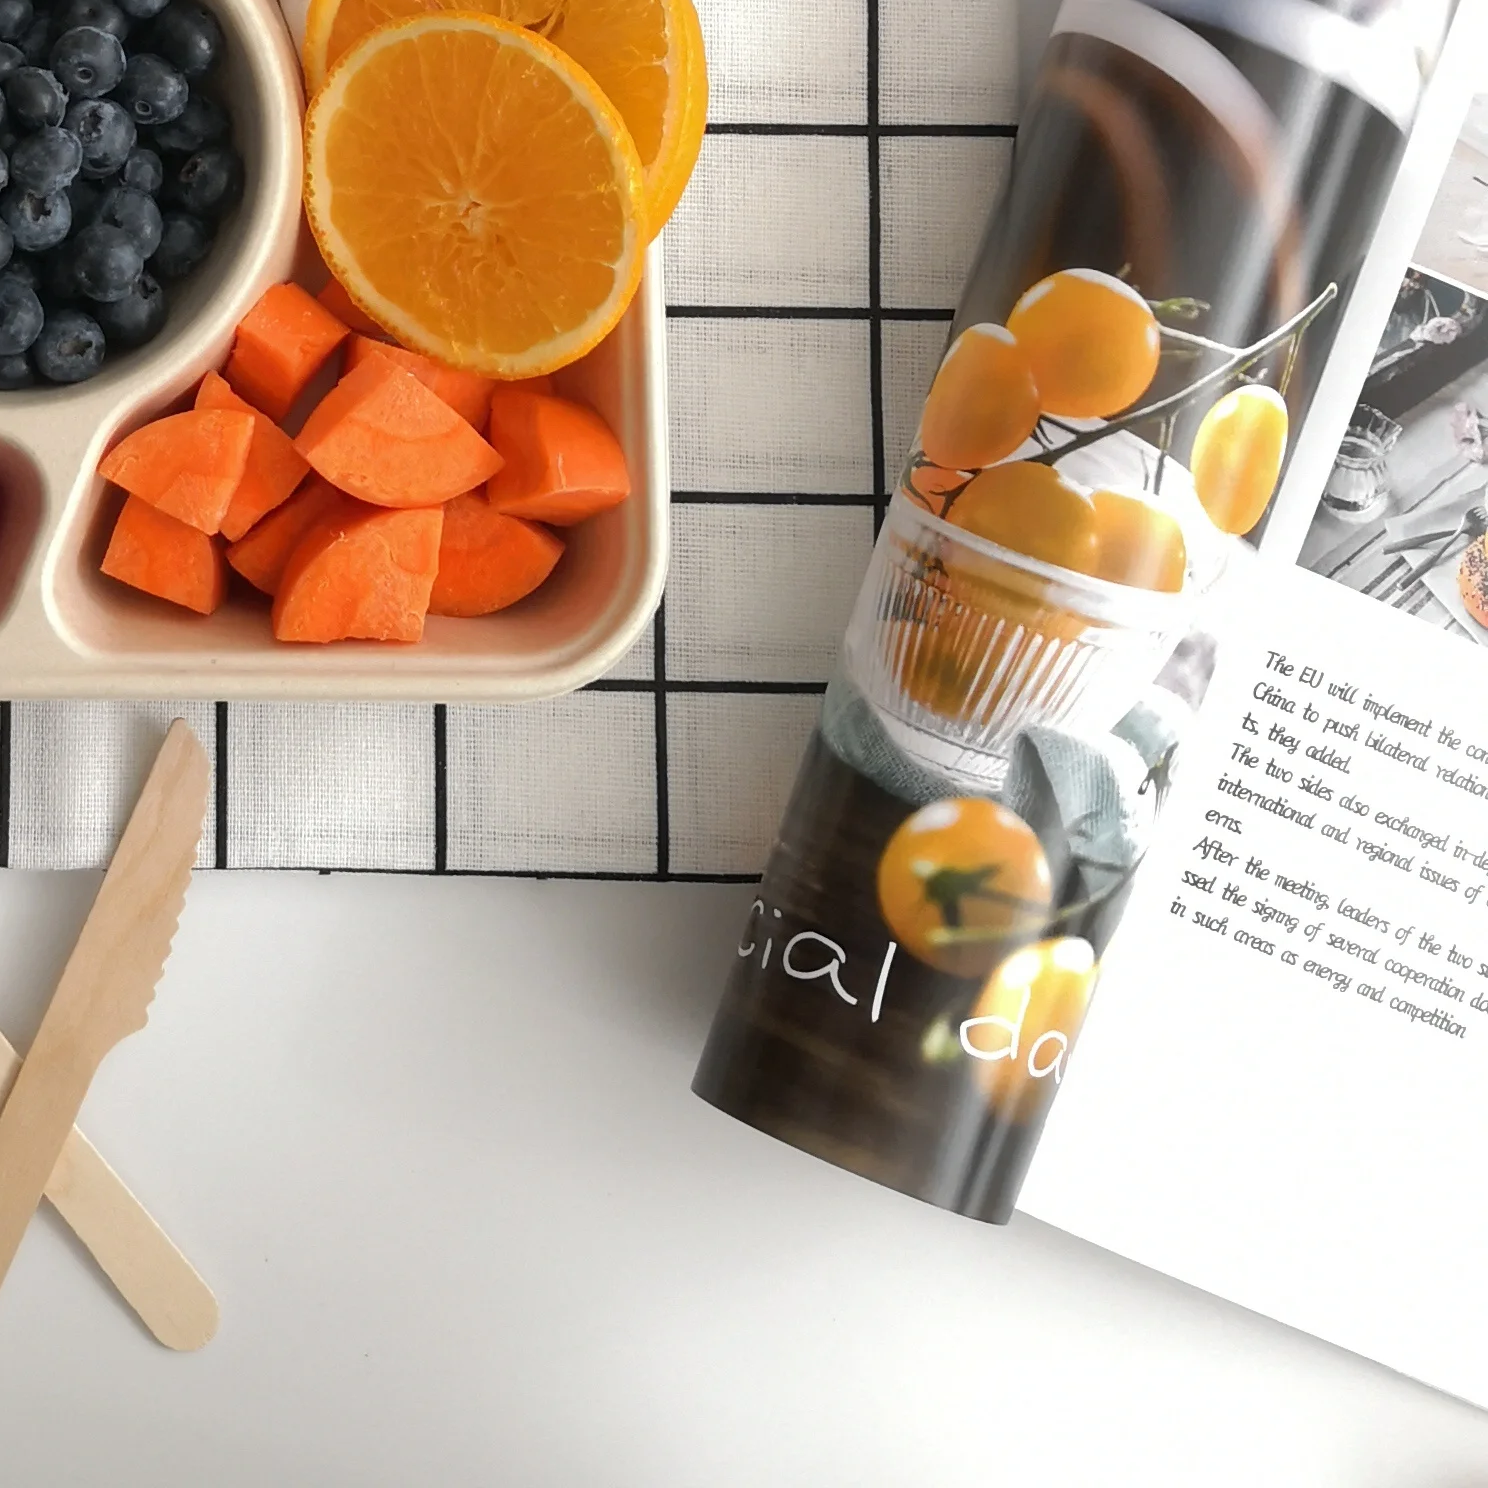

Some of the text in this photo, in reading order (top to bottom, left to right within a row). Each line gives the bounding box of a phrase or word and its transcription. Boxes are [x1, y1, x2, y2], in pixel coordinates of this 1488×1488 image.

[1252, 681, 1296, 714] China
[1302, 702, 1320, 724] to
[1322, 718, 1361, 742] push
[1364, 730, 1430, 772] bilateral
[1265, 650, 1295, 677] The
[1298, 665, 1325, 689] EU
[1327, 682, 1359, 705] will
[1362, 693, 1433, 738] implement
[1437, 725, 1462, 751] the
[1267, 722, 1302, 755] they
[1305, 745, 1352, 775] added.
[1217, 772, 1486, 905] international and regional issues of
[1230, 742, 1260, 769] The
[1265, 757, 1294, 784] two
[1297, 774, 1334, 802] sides
[1338, 794, 1370, 817] also
[1374, 811, 1451, 853] exchanged
[1181, 870, 1218, 894] ssed
[1221, 882, 1248, 907] the
[1303, 922, 1326, 943] of
[1326, 933, 1381, 965] several
[1384, 958, 1466, 1003] cooperation
[1192, 835, 1240, 867] After
[1244, 855, 1271, 881] the
[1336, 897, 1391, 934] leaders
[1394, 926, 1416, 946] of
[1417, 931, 1442, 956] the
[1446, 944, 1473, 970] two
[1169, 895, 1467, 1039] in such areas as energy and competition
